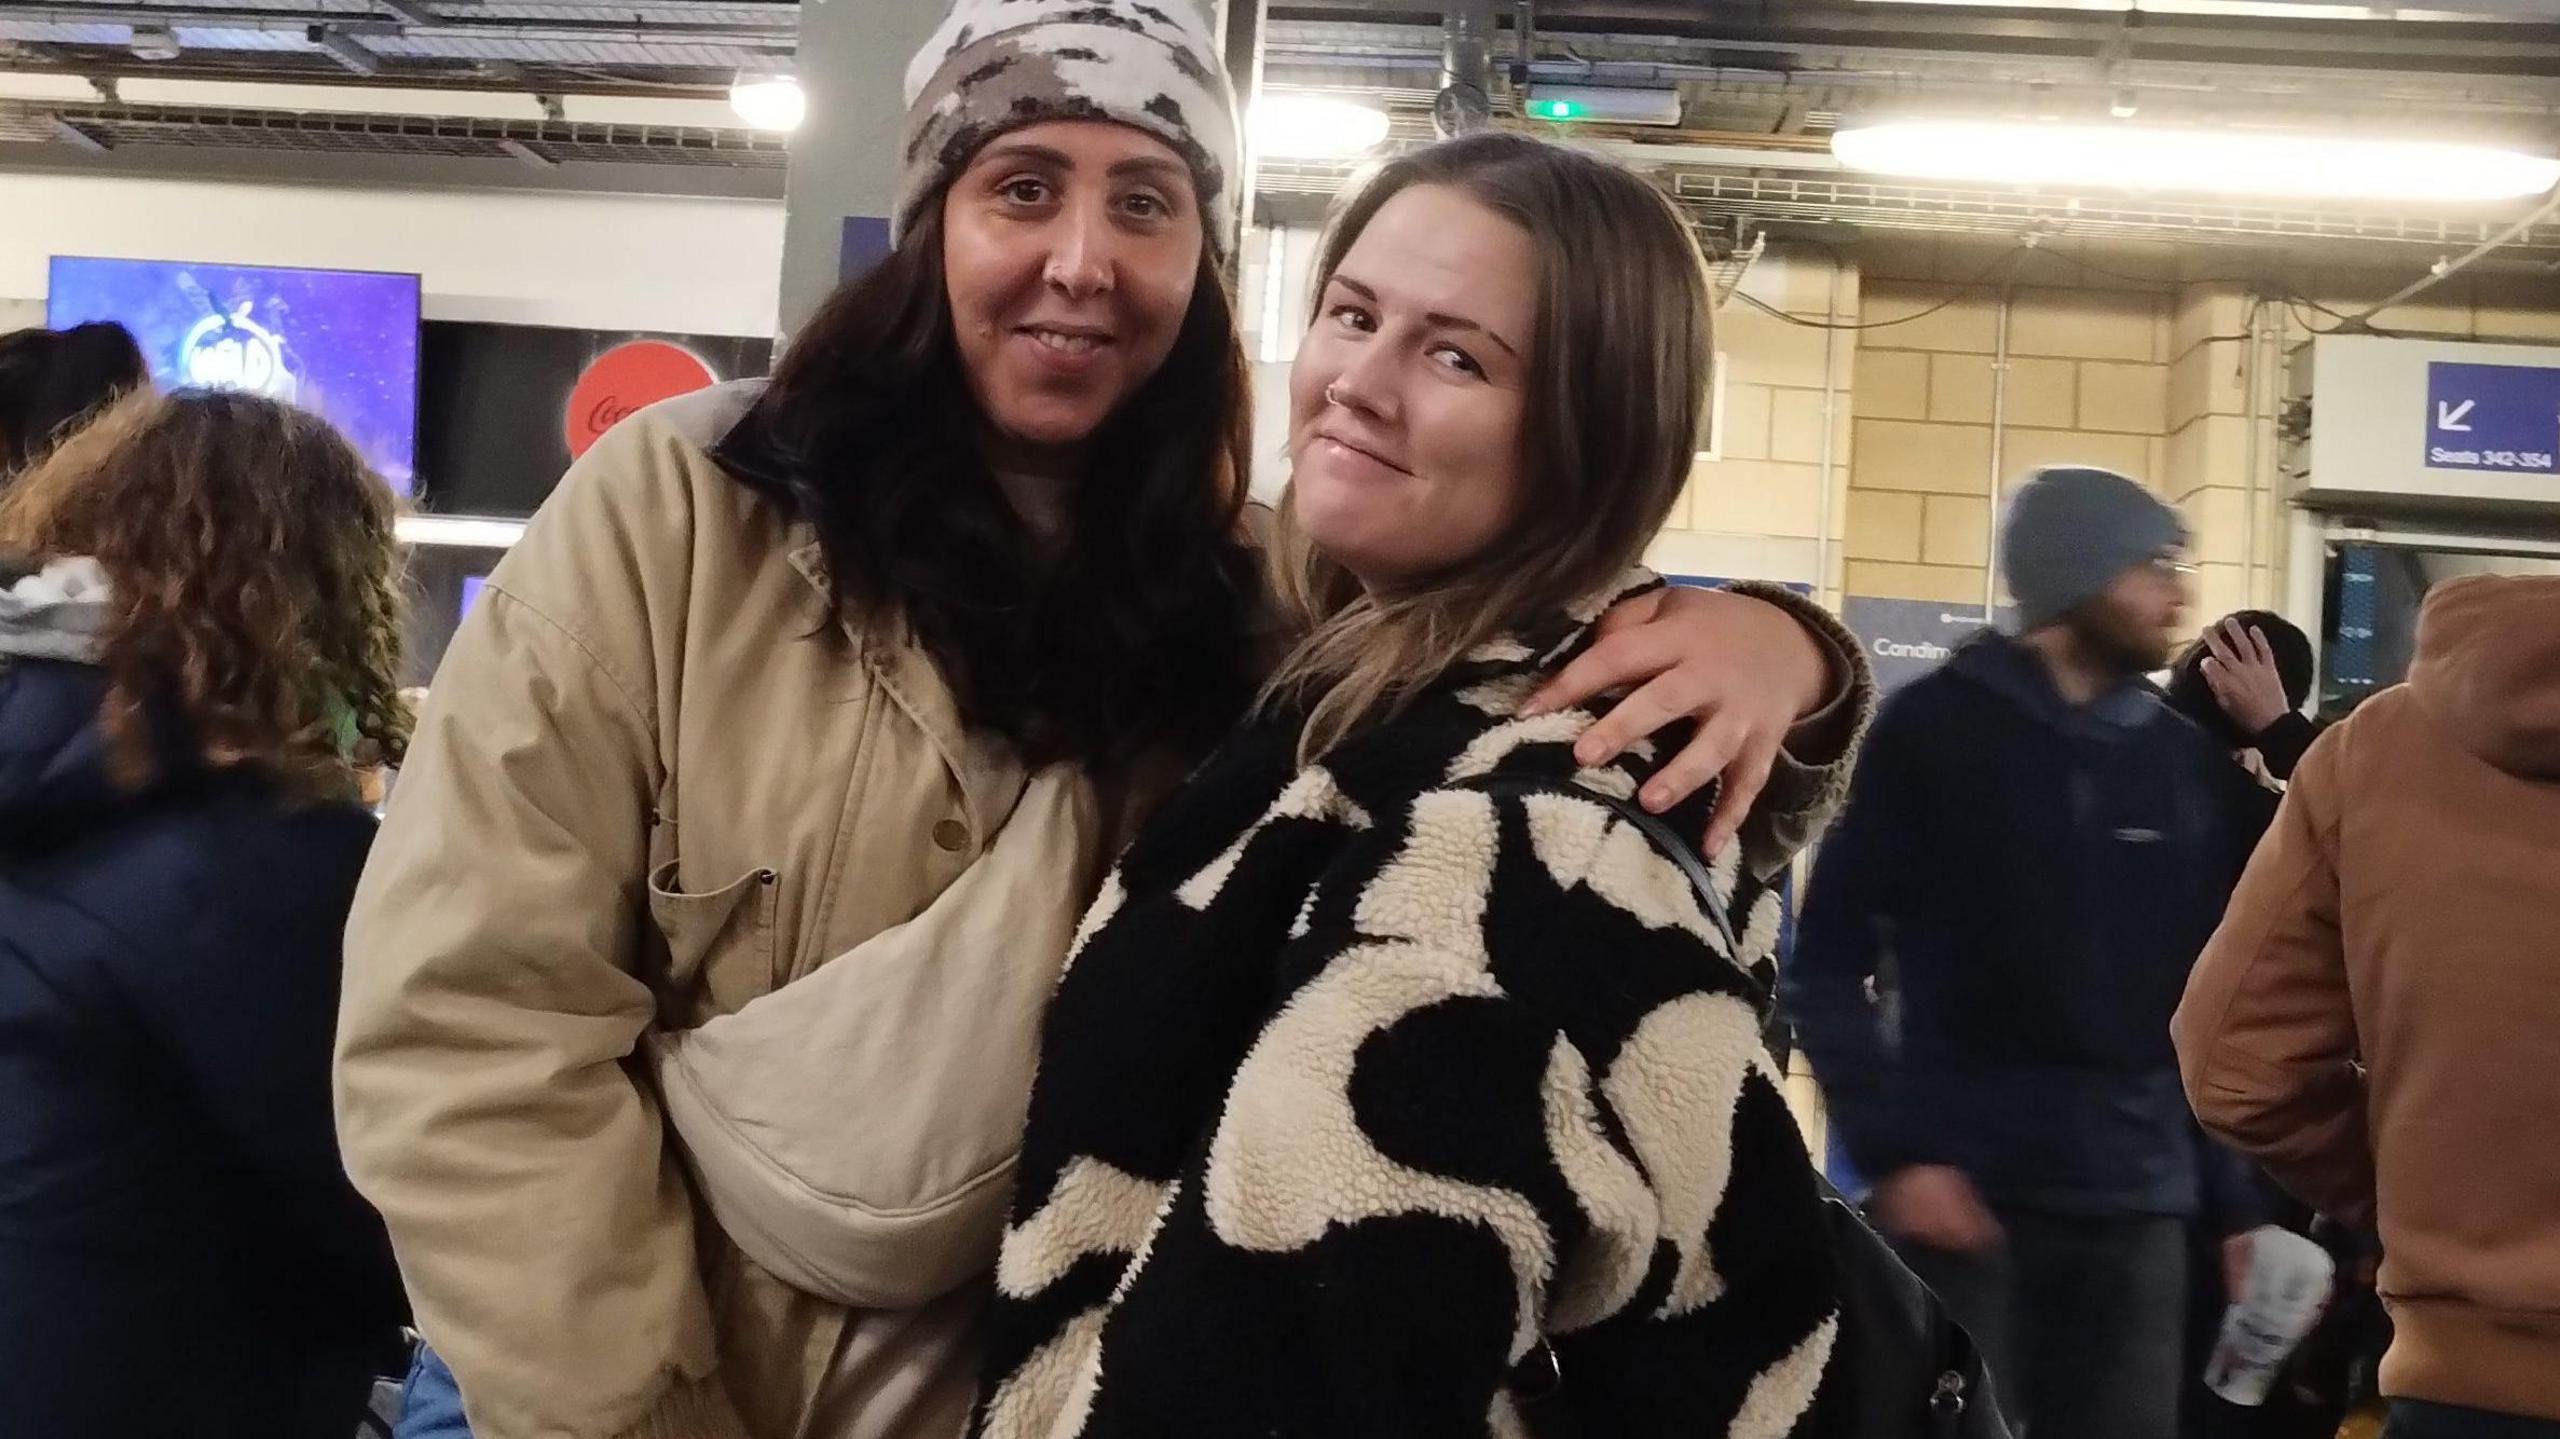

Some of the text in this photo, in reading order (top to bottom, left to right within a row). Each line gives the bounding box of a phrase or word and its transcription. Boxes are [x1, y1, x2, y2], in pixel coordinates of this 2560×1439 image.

[2430, 447, 2552, 468] Seats 342-354
[1872, 637, 1952, 660] Condim
